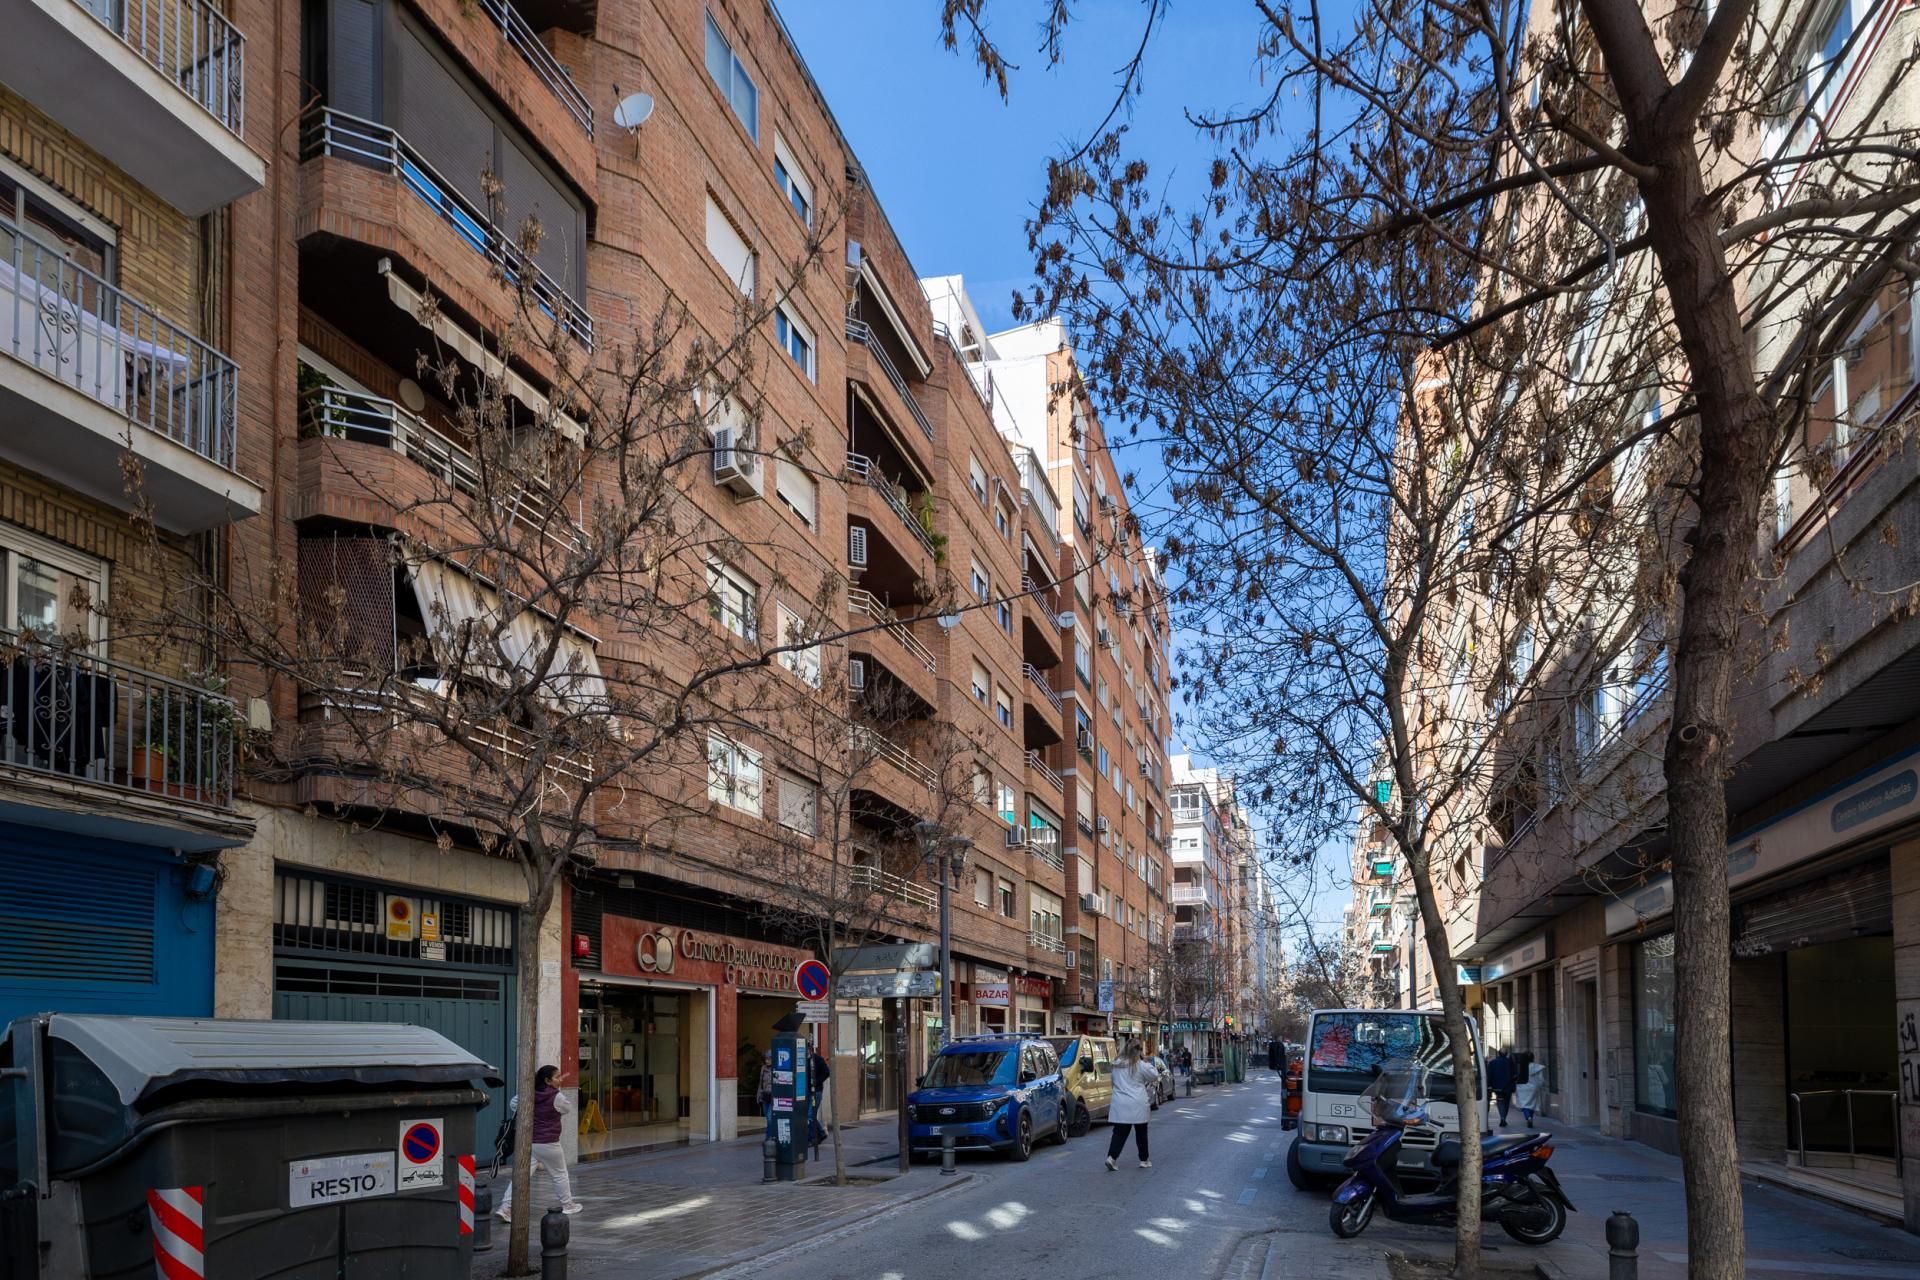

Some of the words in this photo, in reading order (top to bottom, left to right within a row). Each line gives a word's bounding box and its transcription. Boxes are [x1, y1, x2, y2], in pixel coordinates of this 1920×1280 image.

[976, 989, 1008, 999] BAZAR
[777, 1050, 790, 1067] P
[311, 1174, 376, 1199] RESTO
